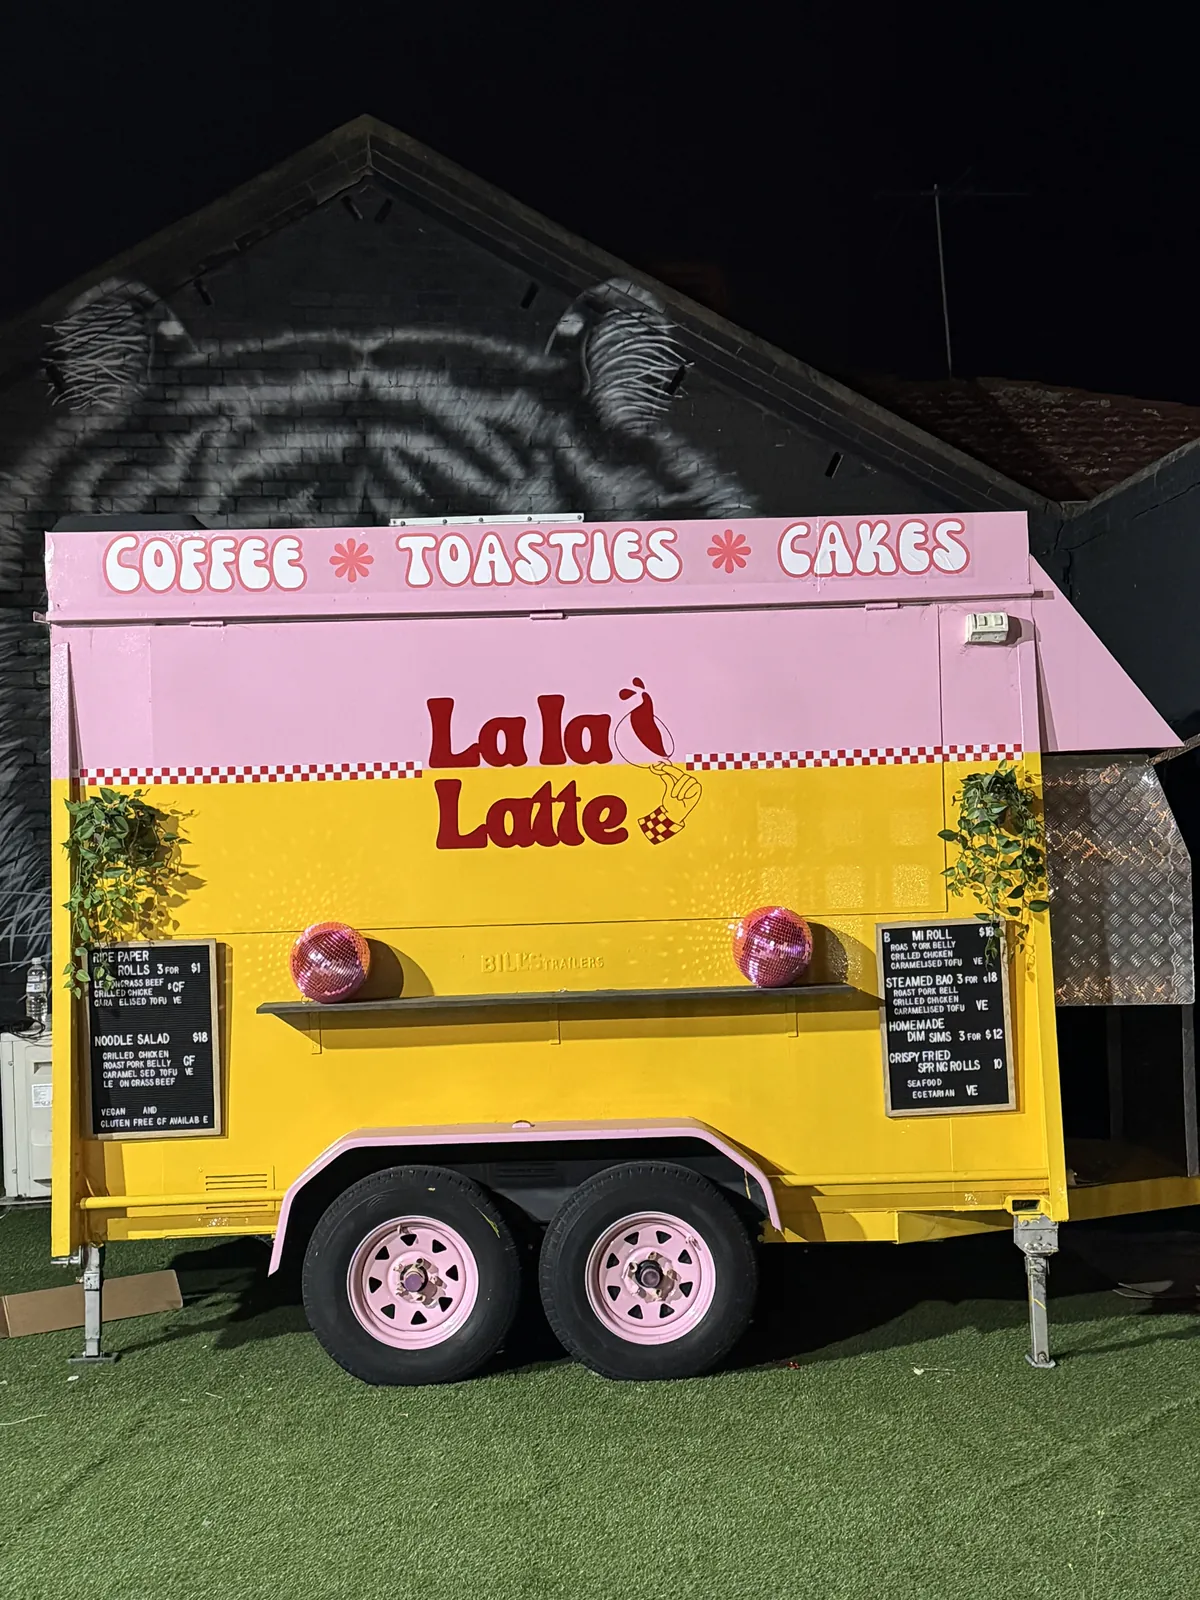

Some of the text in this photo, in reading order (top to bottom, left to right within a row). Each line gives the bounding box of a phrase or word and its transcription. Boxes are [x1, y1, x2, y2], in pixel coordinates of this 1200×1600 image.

[103, 517, 971, 594] COFFEE TOASTIES CAKES
[434, 778, 629, 850] Latte
[912, 930, 924, 941] MI
[927, 929, 952, 940] ROLL
[891, 943, 908, 951] ROAS
[933, 941, 955, 949] BELLY
[93, 950, 149, 963] RICE PAPER
[891, 950, 953, 961] GRILLED CHICKEN
[891, 960, 942, 969] CARAMELISED
[973, 957, 983, 965] VE
[118, 963, 200, 976] ROLLS 3 FOR $1
[145, 978, 164, 986] BEEF
[886, 975, 934, 989] STEAMED
[936, 974, 953, 985] BAO
[957, 974, 963, 984] 3
[965, 976, 978, 984] FOR
[94, 987, 126, 998] GRILLED
[128, 988, 154, 998] CHICKE
[893, 989, 915, 997] ROAST
[939, 986, 958, 994] BELL
[149, 997, 167, 1005] TOFU
[173, 996, 182, 1004] VE
[893, 995, 959, 1007] GRILLED CHICKEN
[894, 1000, 988, 1015] CARAMELISED TOFU VE
[889, 1018, 945, 1032] HOMEMADE
[95, 1032, 209, 1046] NOODLE SALAD $18
[907, 1031, 925, 1042] DIM
[929, 1031, 952, 1043] SIMS
[959, 1031, 965, 1041] 3
[103, 1050, 169, 1060] GRILLED CHICKEN
[890, 1050, 951, 1064] CRISPY FRIED
[103, 1061, 125, 1069] ROAST
[147, 1059, 171, 1067] BELLY
[183, 1055, 195, 1066] GF
[950, 1060, 980, 1071] ROLLS
[994, 1059, 1002, 1069] 10
[159, 1068, 177, 1076] TOFU
[155, 1078, 175, 1086] BEEF
[966, 1085, 978, 1096] VE
[102, 1106, 157, 1116] VEGAN AND
[101, 1119, 130, 1127] GLUTEN
[133, 1118, 153, 1126] FREE
